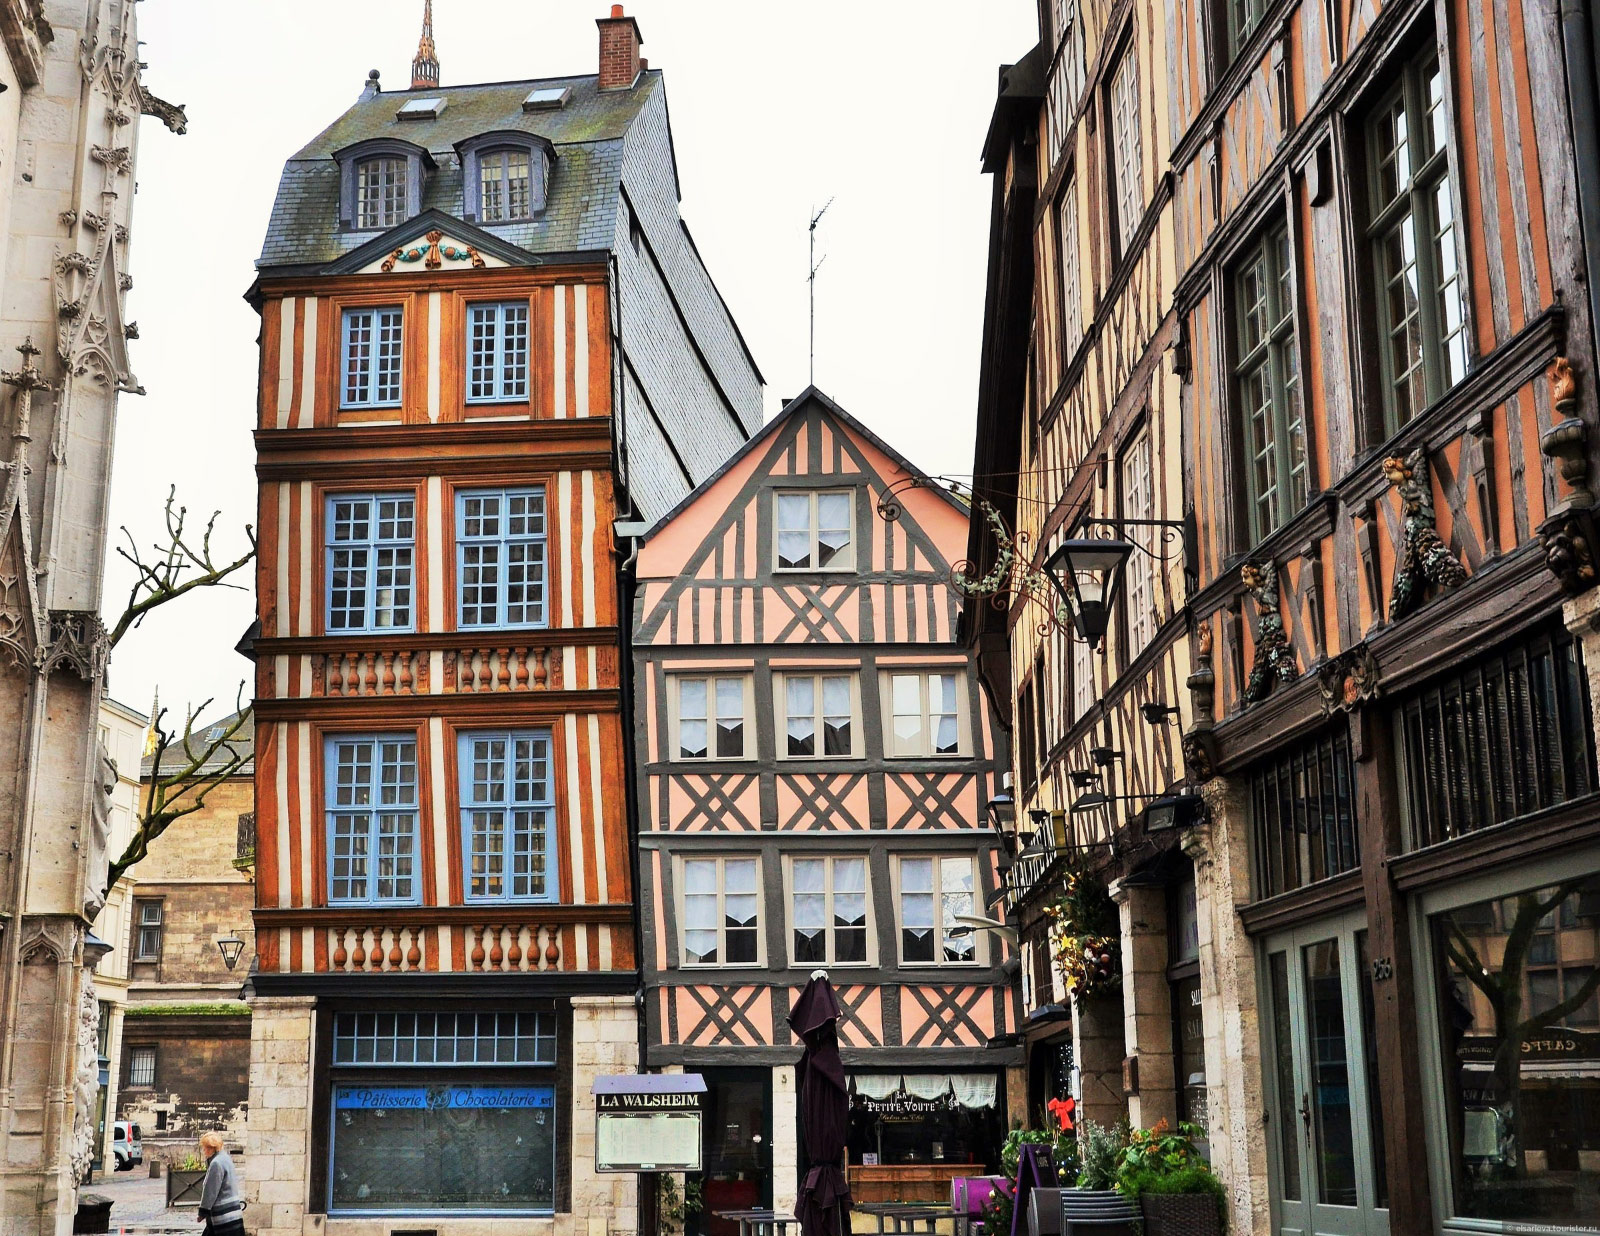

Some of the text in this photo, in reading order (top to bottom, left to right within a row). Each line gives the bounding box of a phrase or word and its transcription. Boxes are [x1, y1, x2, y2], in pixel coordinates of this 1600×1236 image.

[357, 1089, 422, 1107] Pâtisserie
[455, 1089, 535, 1107] Chocolaterie
[600, 1094, 699, 1107] LA WALSHEIM
